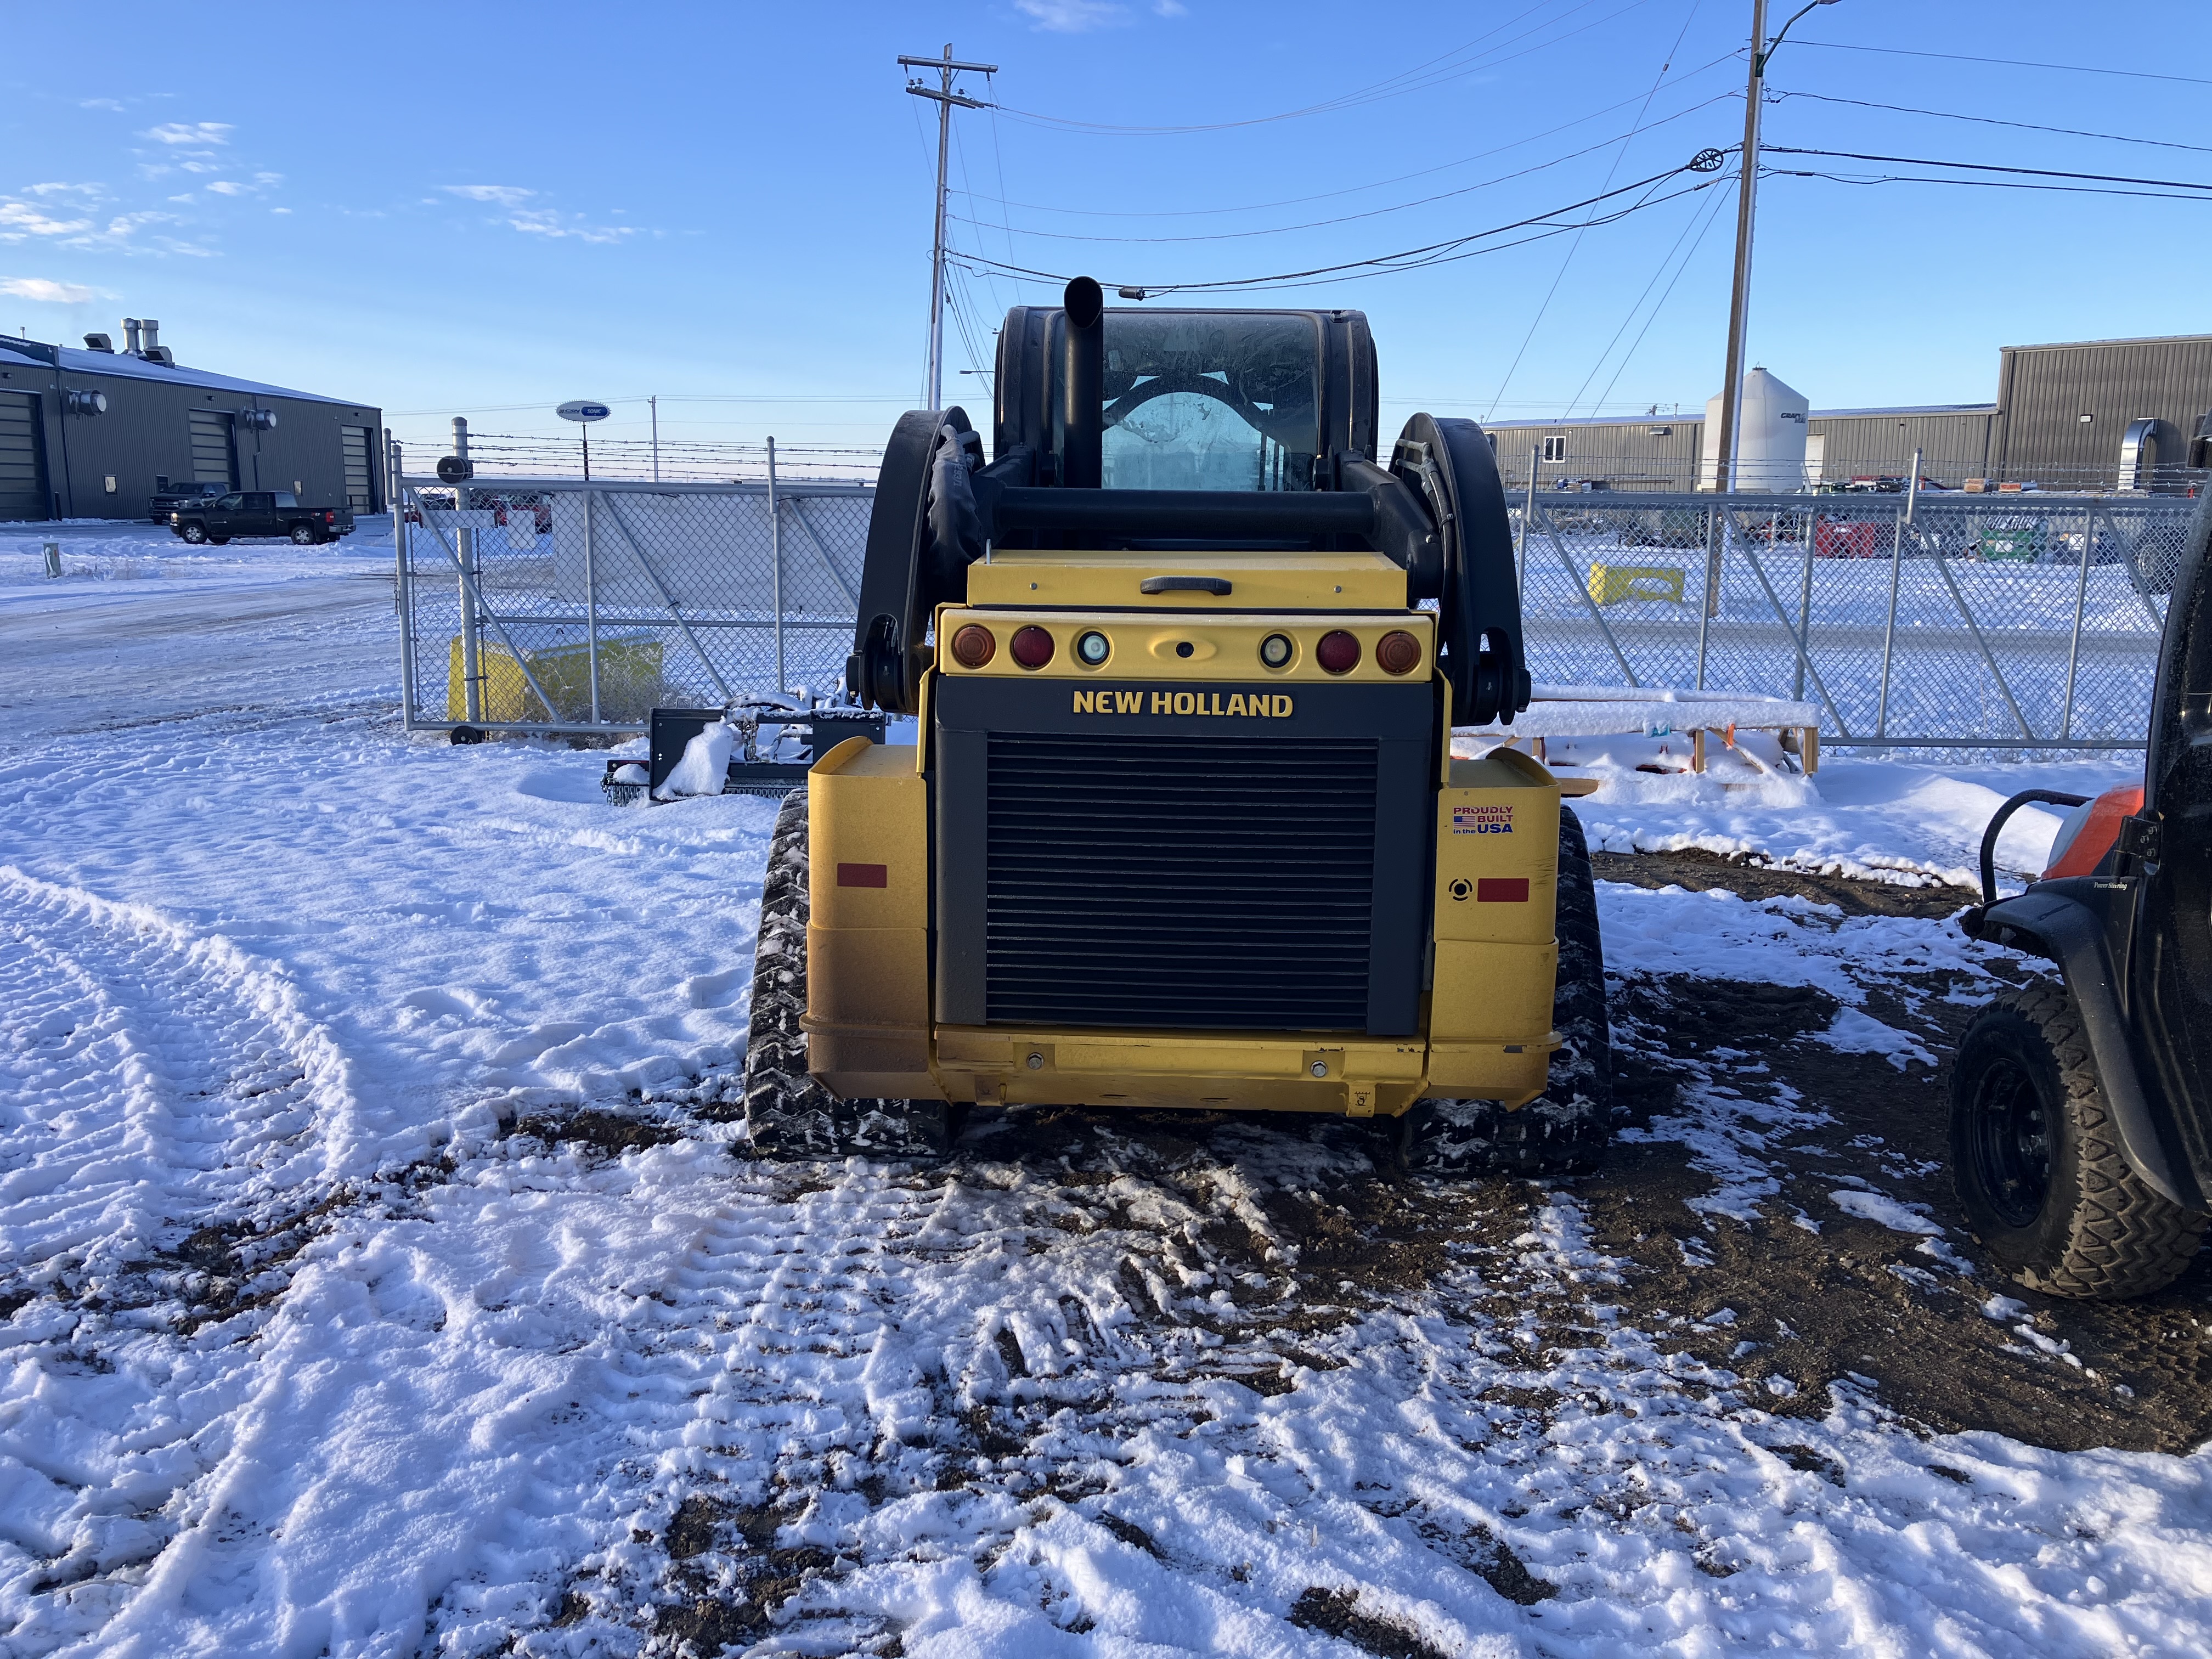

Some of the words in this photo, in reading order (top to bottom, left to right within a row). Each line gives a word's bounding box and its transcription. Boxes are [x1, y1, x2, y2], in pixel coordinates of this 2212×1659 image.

[1073, 691, 1143, 714] NEW
[1152, 692, 1294, 718] HOLLAND
[1453, 806, 1514, 814] PROUDLY
[1477, 823, 1513, 834] USA
